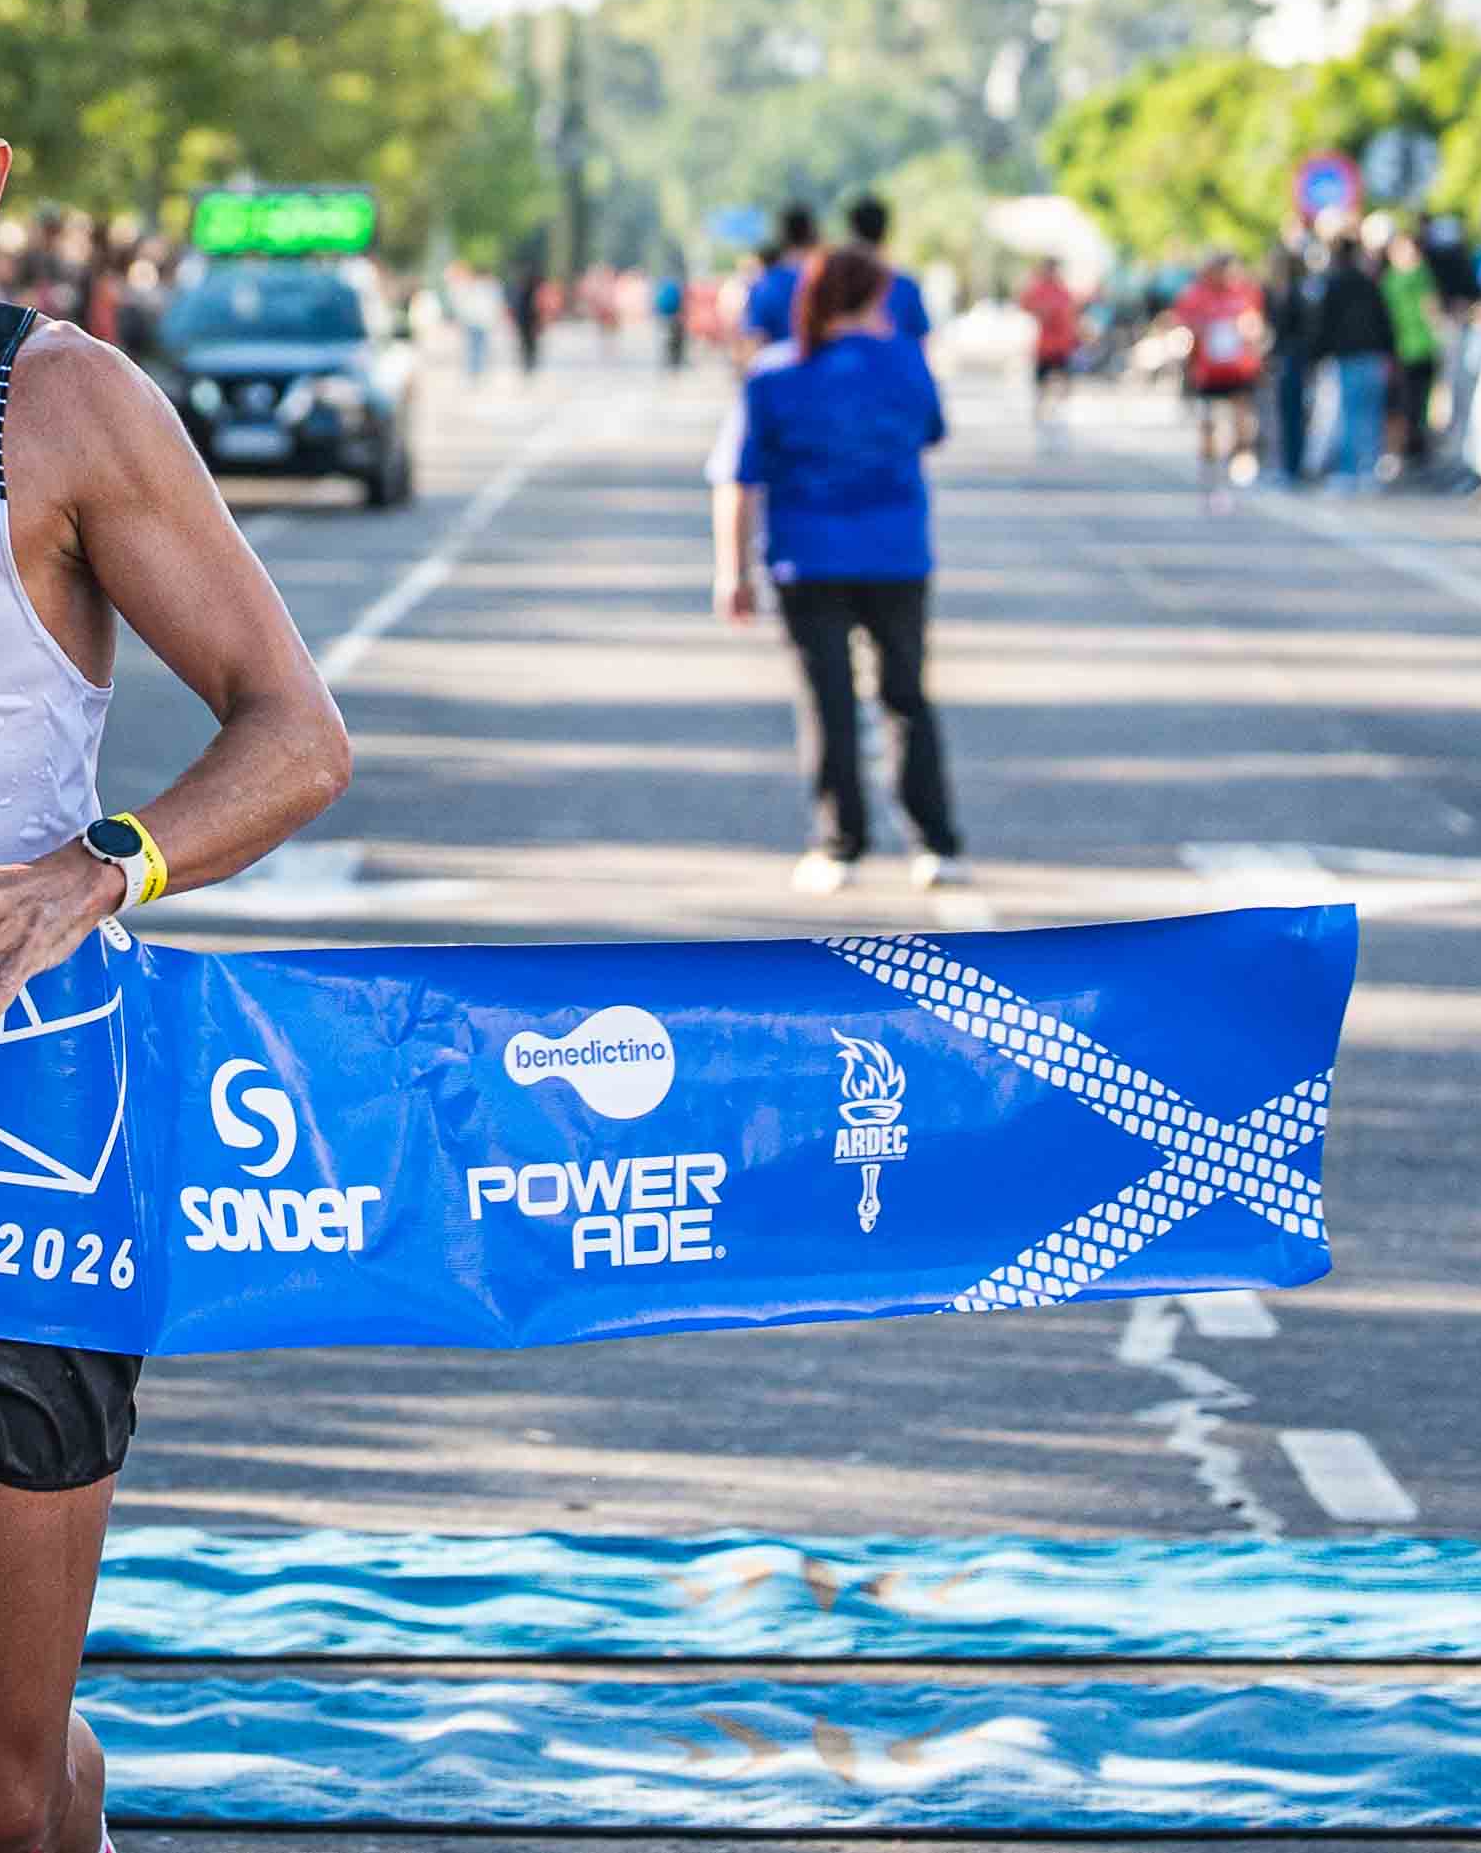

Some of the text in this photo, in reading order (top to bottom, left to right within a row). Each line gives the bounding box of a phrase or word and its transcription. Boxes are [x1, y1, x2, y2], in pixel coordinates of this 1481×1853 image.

[515, 1037, 666, 1070] benedictino
[834, 1125, 910, 1158] ARDEC
[467, 1152, 728, 1221] POWER
